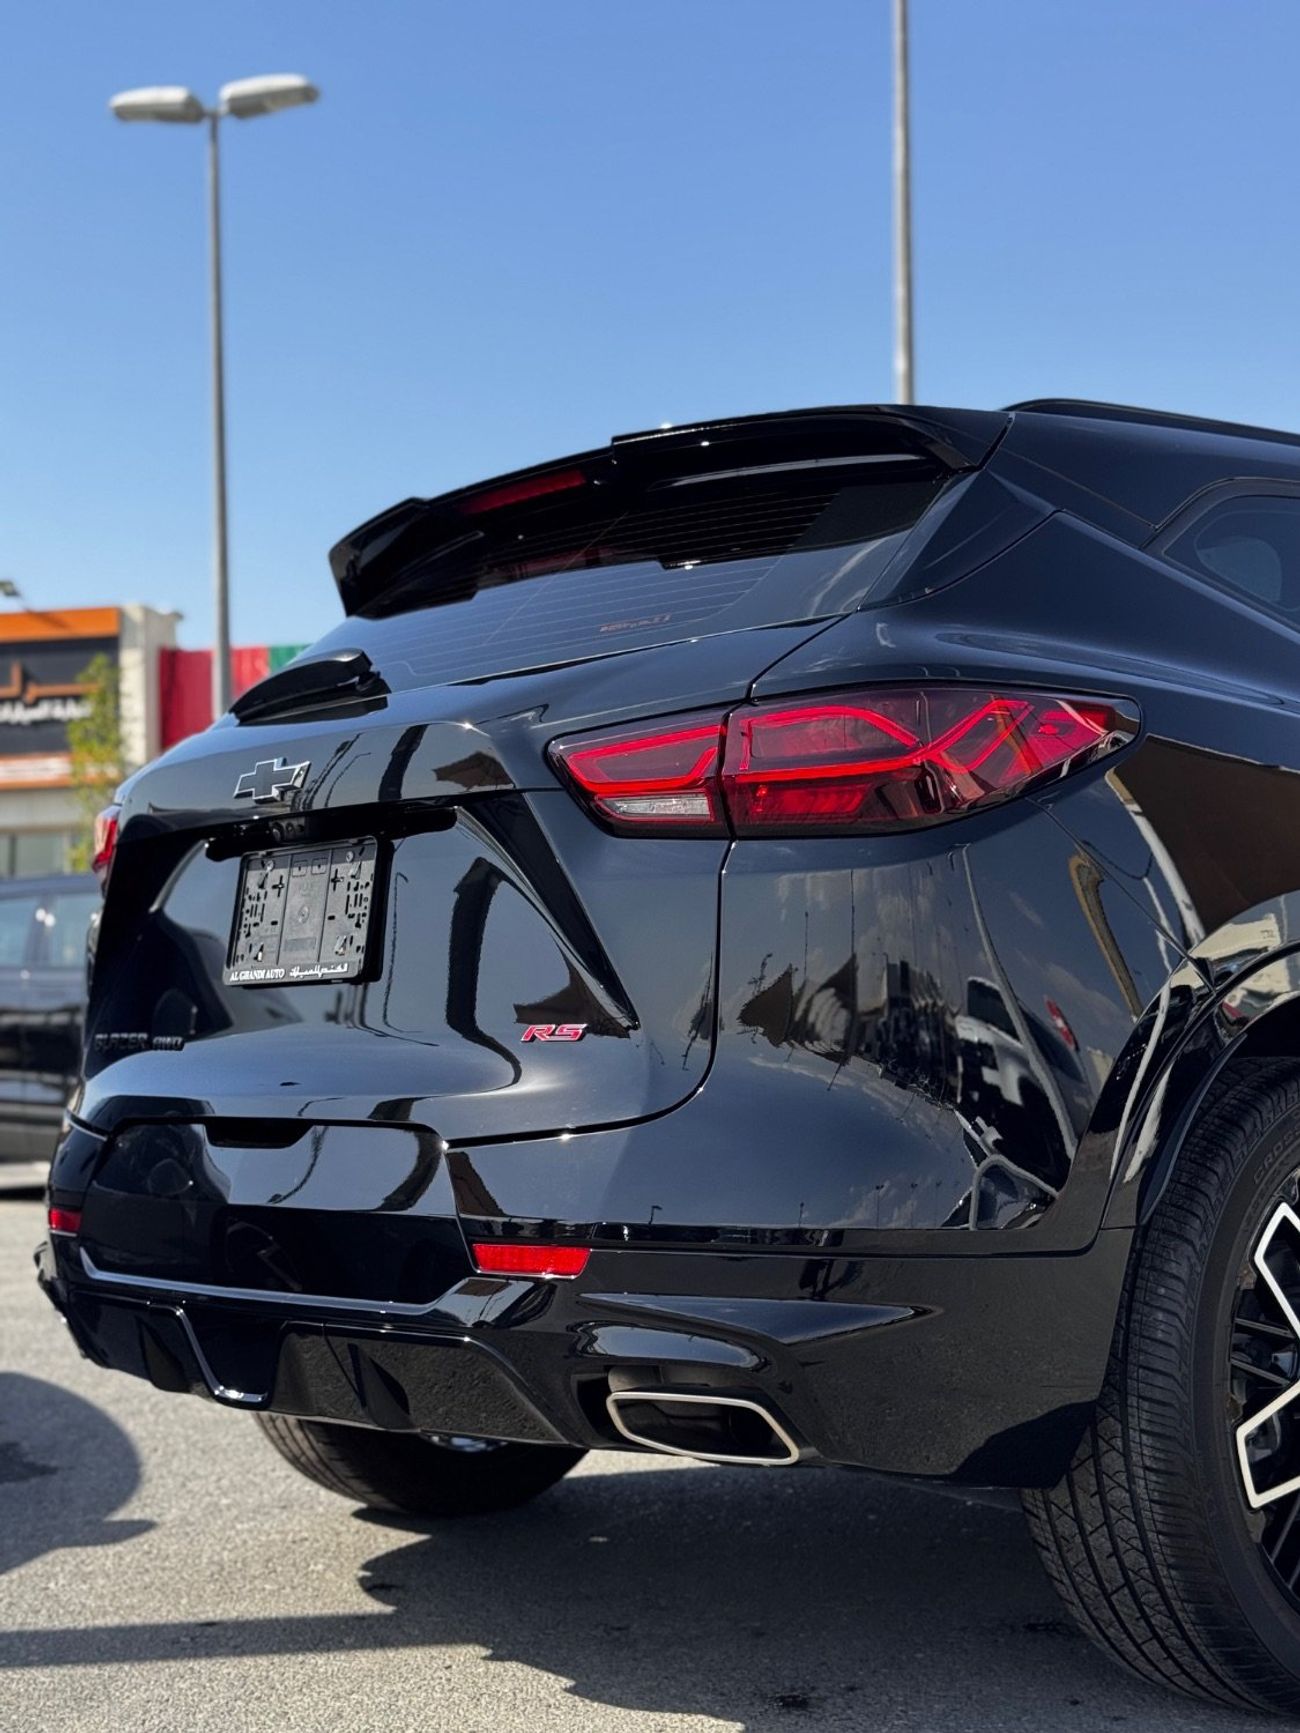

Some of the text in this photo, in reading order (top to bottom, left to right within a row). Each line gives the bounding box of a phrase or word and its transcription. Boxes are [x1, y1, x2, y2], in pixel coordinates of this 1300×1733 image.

[230, 971, 239, 981] AL
[266, 968, 286, 979] AUTO
[520, 1023, 588, 1042] RS
